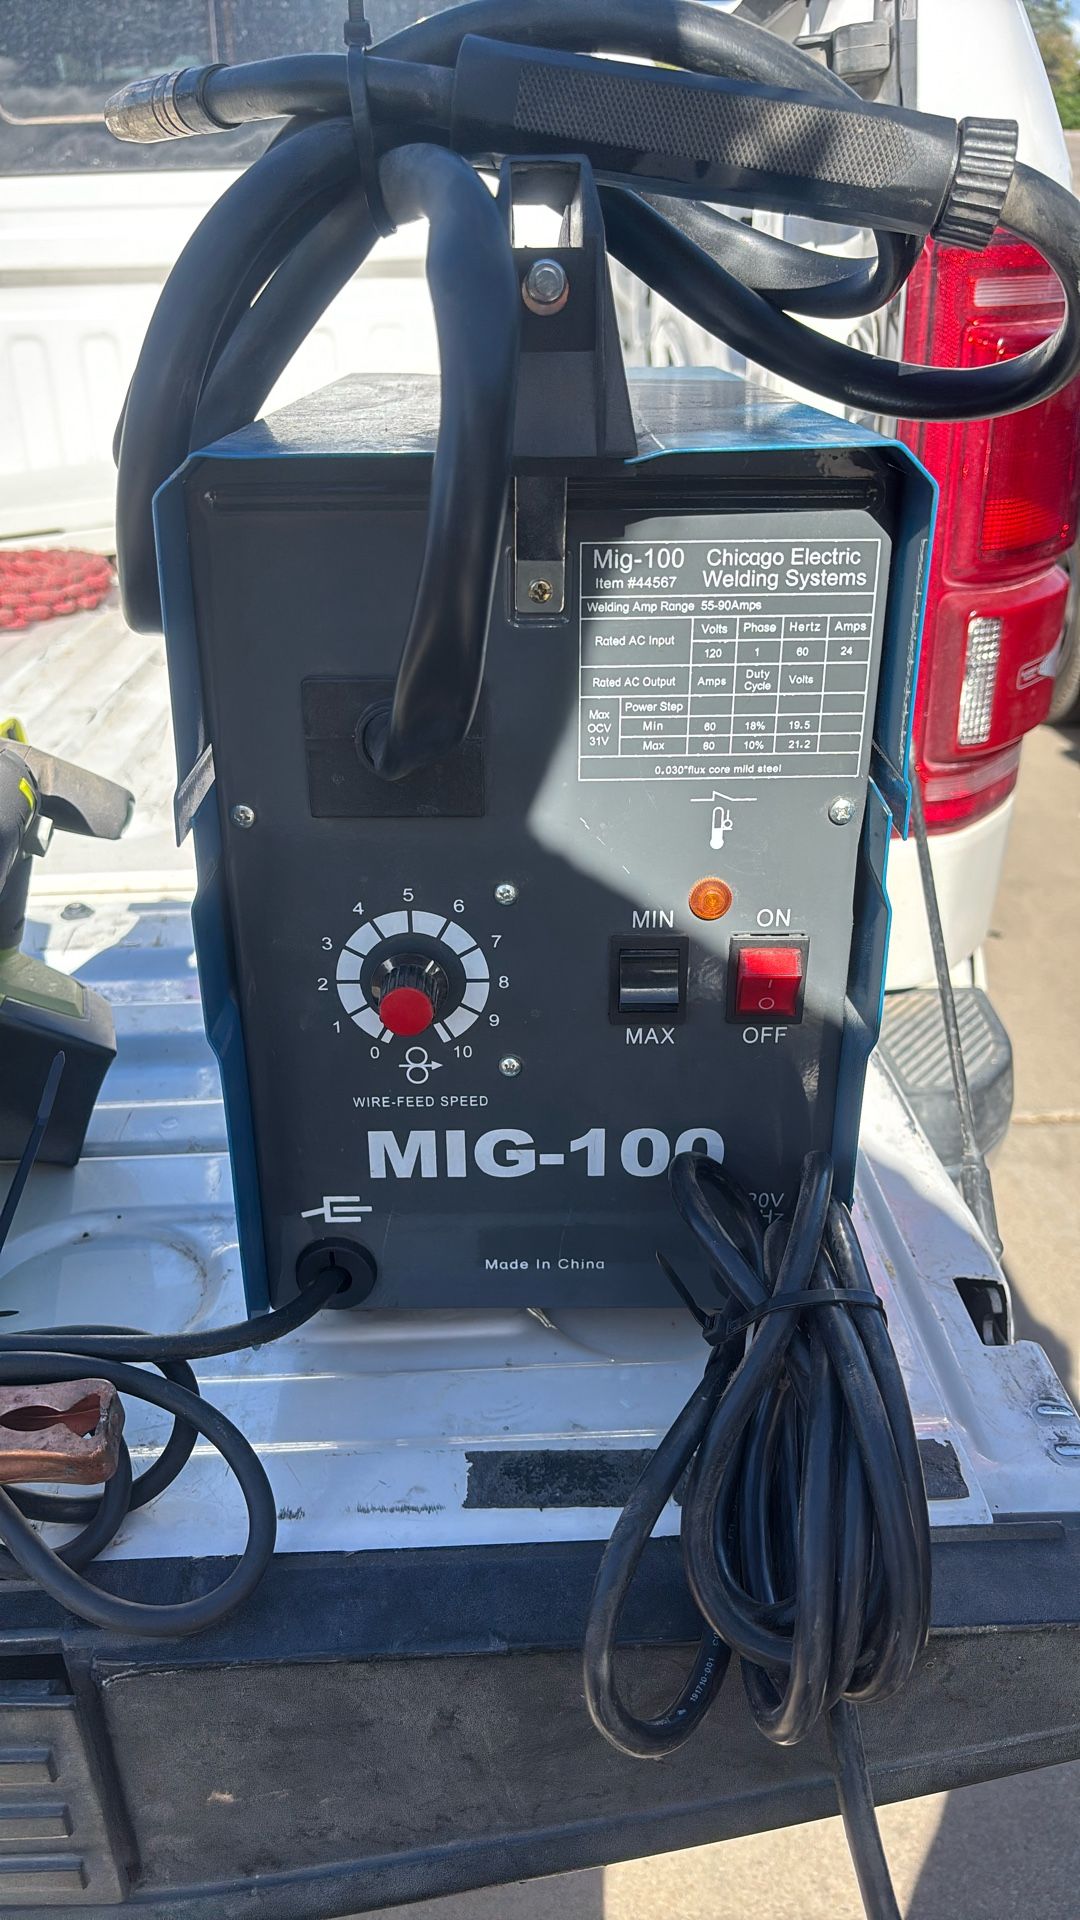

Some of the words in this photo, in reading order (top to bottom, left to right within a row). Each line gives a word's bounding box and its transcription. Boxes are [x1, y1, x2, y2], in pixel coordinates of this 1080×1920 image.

[594, 548, 684, 573] Mig-100
[707, 549, 784, 569] Chicago
[791, 548, 861, 565] Electric
[596, 578, 623, 589] Item
[627, 576, 677, 588] #44567
[703, 570, 778, 590] Welding
[785, 569, 866, 590] Systems
[587, 602, 629, 614] Welding
[632, 601, 657, 613] Amp
[661, 601, 695, 613] Range
[701, 600, 762, 612] 55-90Amps
[701, 624, 728, 634] Volts
[744, 622, 776, 632] Phase
[790, 622, 820, 632] Hertz
[835, 621, 866, 633] Amps
[595, 636, 625, 646] Rated
[629, 635, 645, 645] AC
[649, 635, 674, 647] Input
[705, 648, 722, 658] 120
[755, 648, 759, 656] 1
[841, 646, 852, 655] 24
[746, 669, 770, 682] Duty
[789, 675, 813, 684] Volts
[593, 677, 621, 687] Rated
[624, 677, 639, 686] AC
[643, 677, 675, 688] Output
[697, 677, 726, 687] Amps
[744, 681, 771, 692] Cycle
[625, 702, 657, 712] Power
[660, 701, 683, 713] Step
[589, 710, 610, 719] Max
[588, 723, 611, 733] OCV
[643, 721, 663, 730] Min
[745, 721, 765, 730] 18%
[789, 721, 810, 729] 19.5
[590, 736, 609, 746] 31V
[643, 741, 664, 750] Max
[744, 741, 764, 749] 10%
[788, 740, 810, 749] 21.2
[734, 764, 754, 773] mild
[757, 764, 781, 773] steel
[403, 888, 414, 901] 5
[353, 902, 364, 915] 4
[454, 900, 464, 912] 6
[633, 911, 673, 928] MIN
[757, 909, 790, 927] ON
[322, 937, 332, 950] 3
[492, 935, 501, 948] 7
[318, 978, 328, 990] 2
[499, 976, 509, 988] 8
[489, 1014, 499, 1026] 9
[333, 1021, 340, 1033] 1
[626, 1028, 674, 1044] MAX
[743, 1027, 787, 1043] OFF
[371, 1047, 379, 1059] 0
[454, 1046, 472, 1058] 10
[353, 1096, 434, 1107] WIRE-FEED
[441, 1096, 488, 1106] SPEED
[486, 1259, 528, 1269] Made
[537, 1259, 550, 1269] In
[558, 1259, 604, 1269] China
